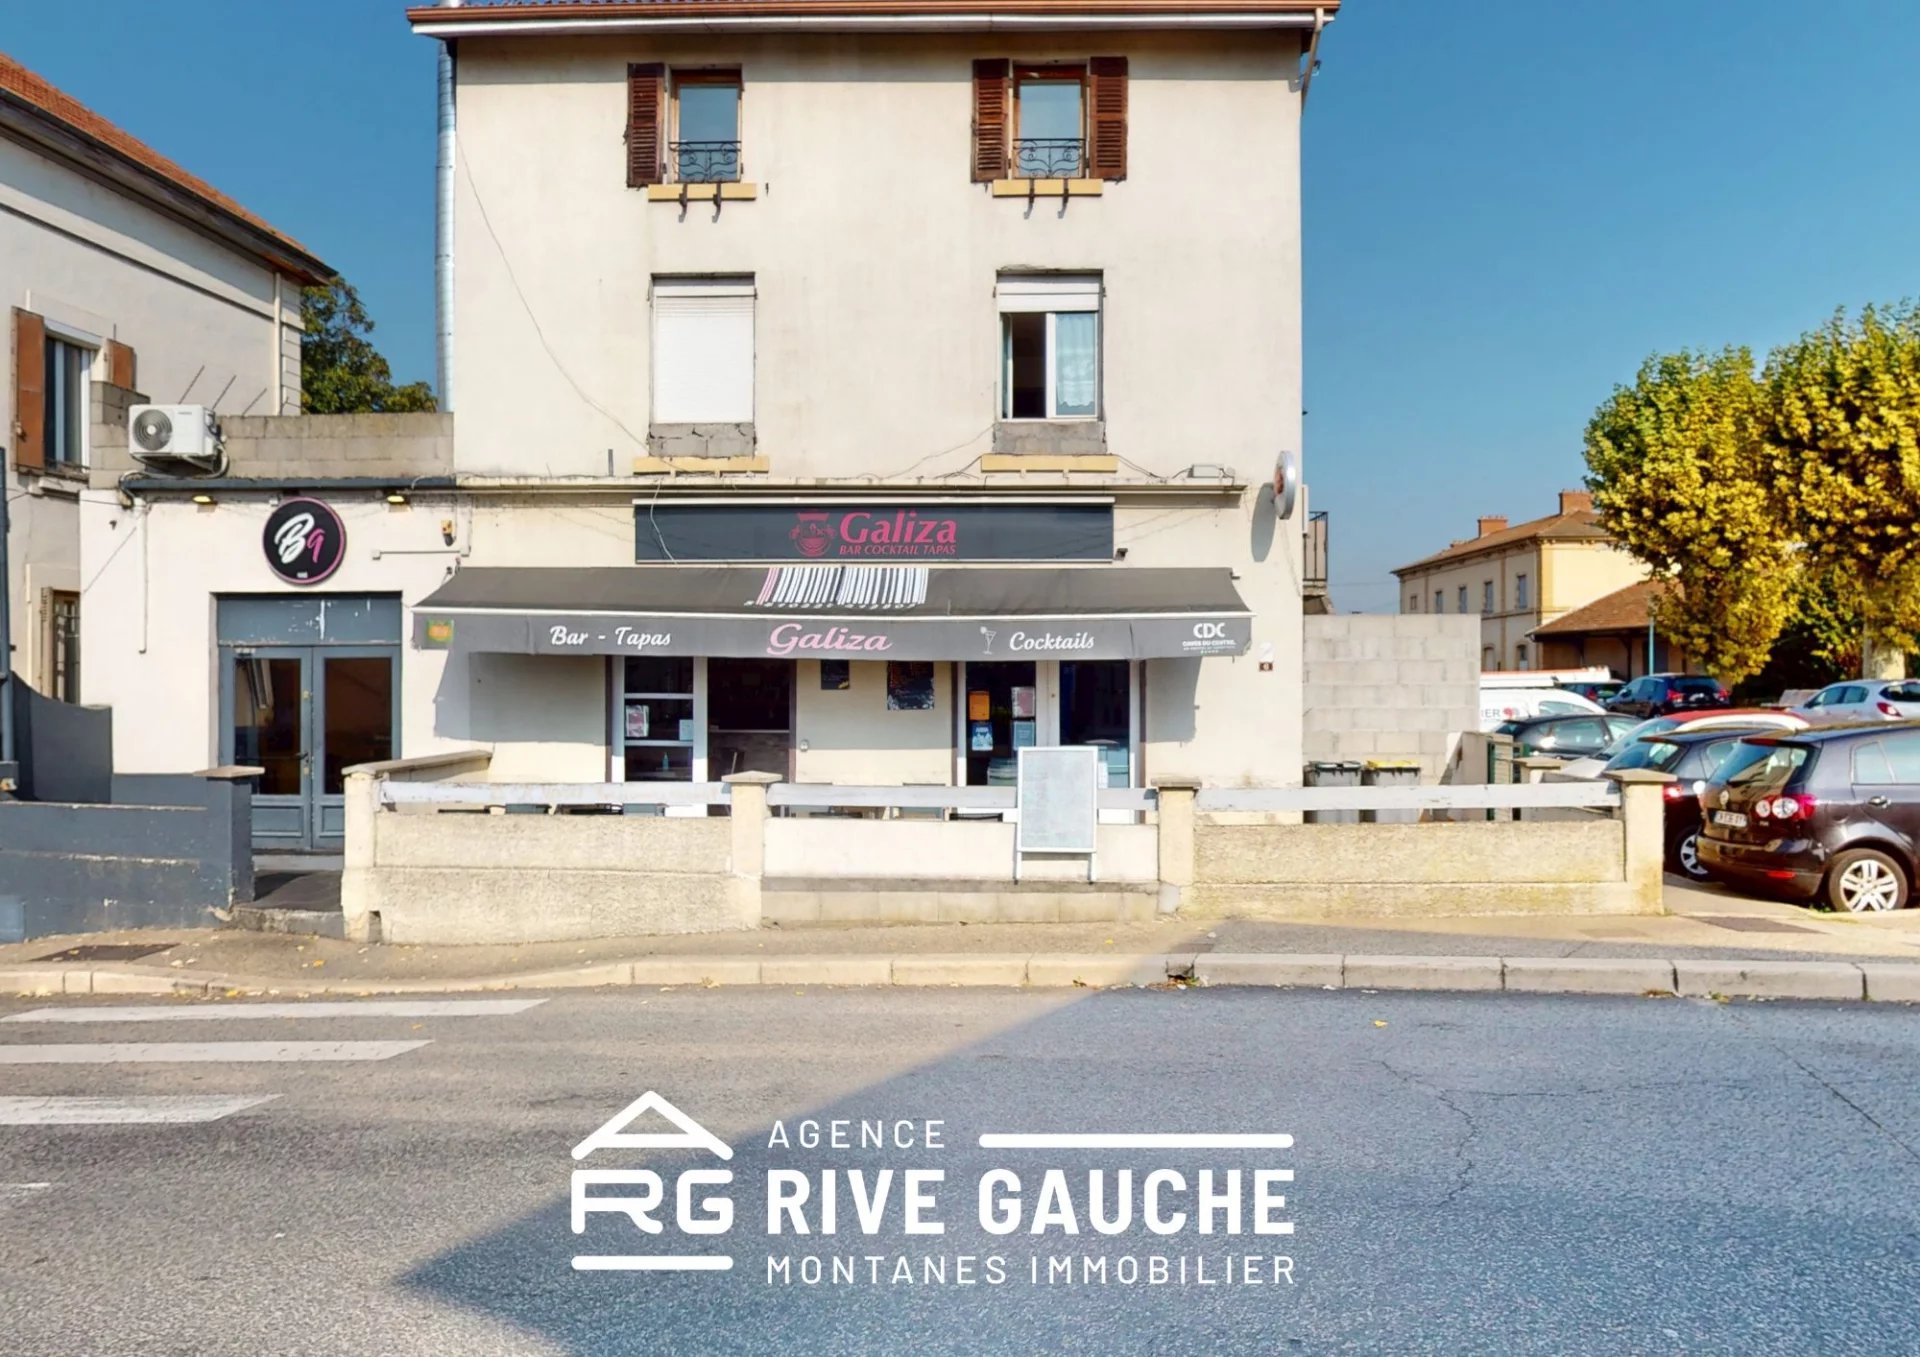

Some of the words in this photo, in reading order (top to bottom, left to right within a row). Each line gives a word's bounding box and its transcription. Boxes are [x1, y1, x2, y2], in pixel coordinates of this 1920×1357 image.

[840, 509, 957, 544] Galiza
[839, 544, 861, 555] BAR
[864, 544, 919, 555] COCKTAIL
[923, 544, 956, 555] TAPAS
[549, 625, 589, 645] Bar
[615, 626, 671, 650] Tapas
[766, 623, 893, 655] Galiza
[1009, 631, 1095, 651] Cocktails
[1193, 622, 1226, 639] CDC
